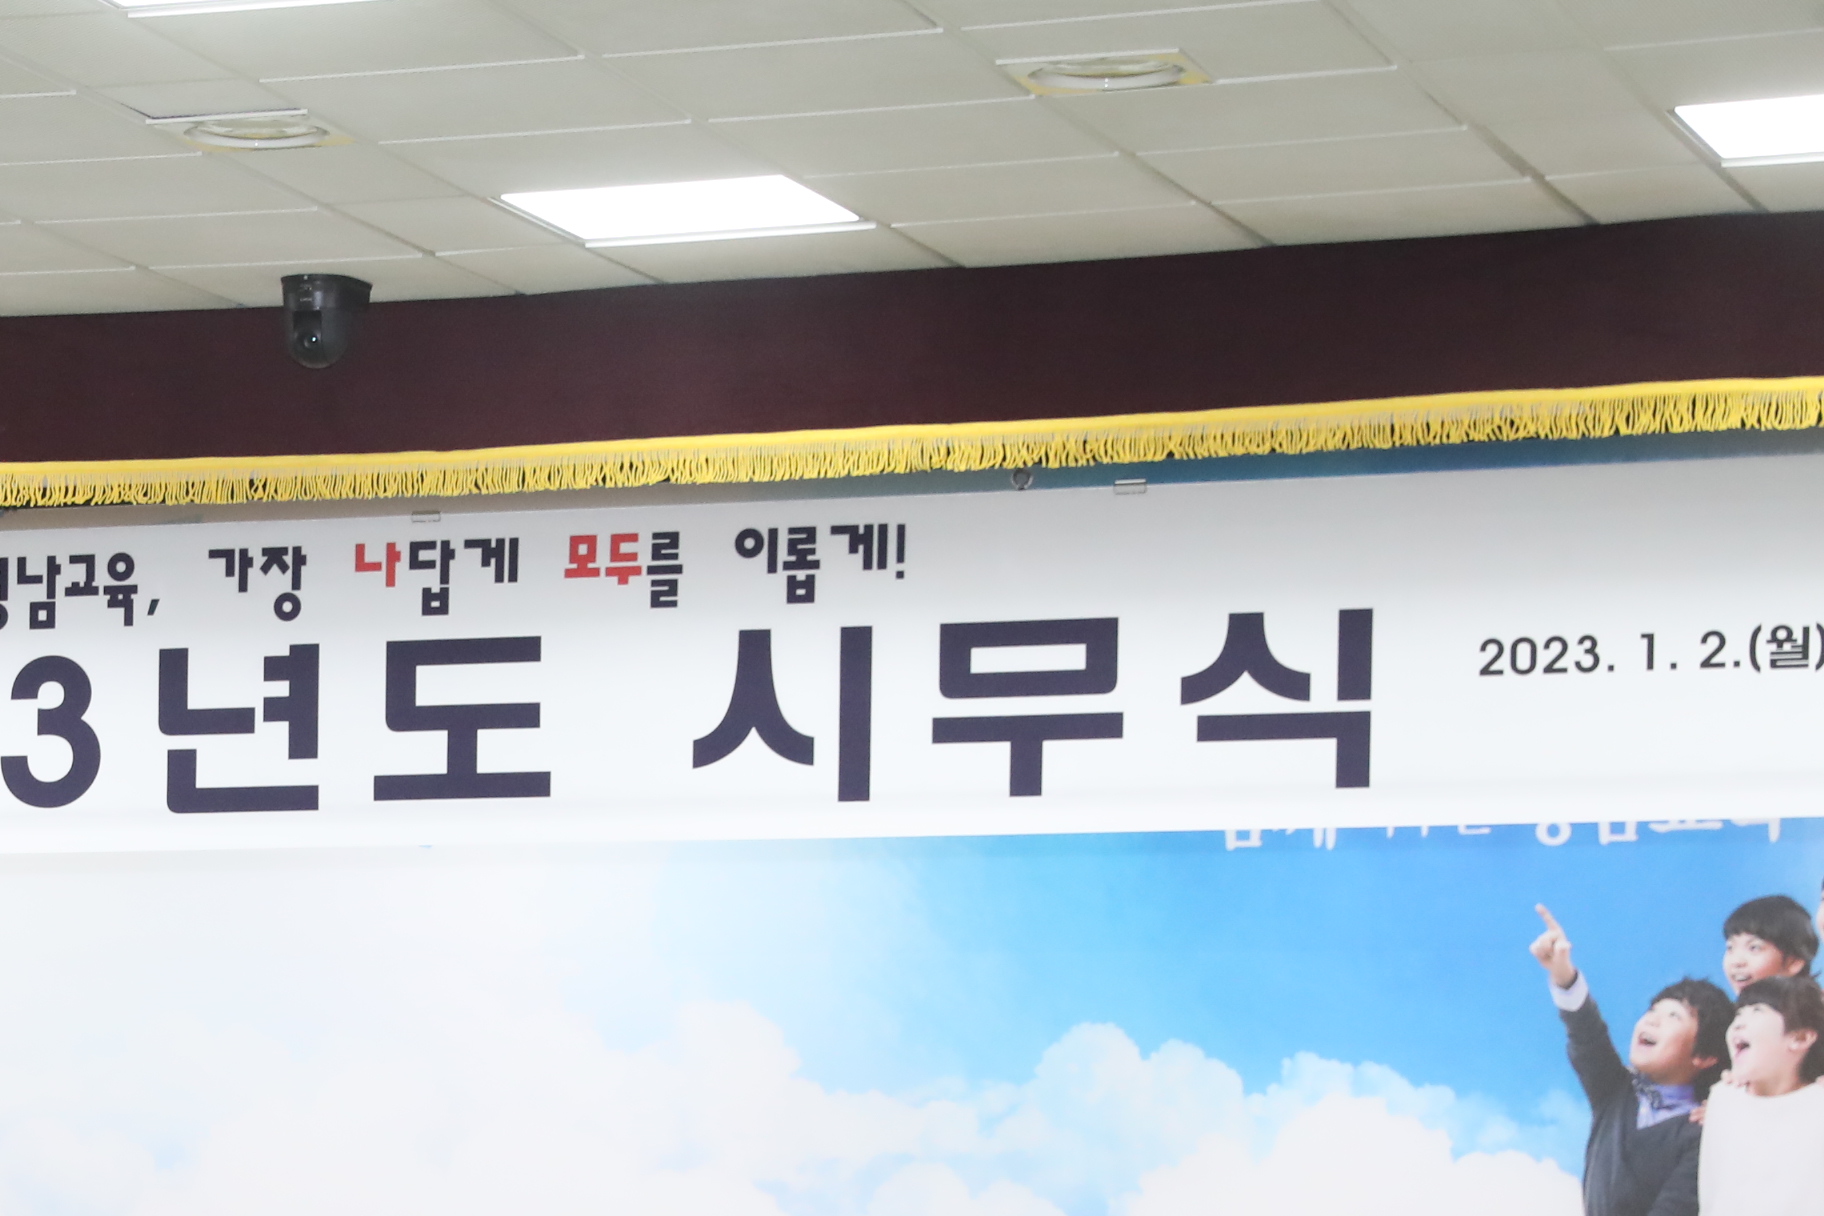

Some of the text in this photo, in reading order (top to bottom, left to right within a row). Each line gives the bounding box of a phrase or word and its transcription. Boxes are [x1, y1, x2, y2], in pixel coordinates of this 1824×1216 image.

[207, 545, 307, 622] 가장
[353, 536, 519, 617] 나답게
[563, 529, 683, 609] 모두를
[734, 523, 907, 604] 이롭게!
[1478, 634, 1615, 677] 2023.
[1640, 632, 1678, 671] 1.
[692, 607, 1374, 803] 시무식
